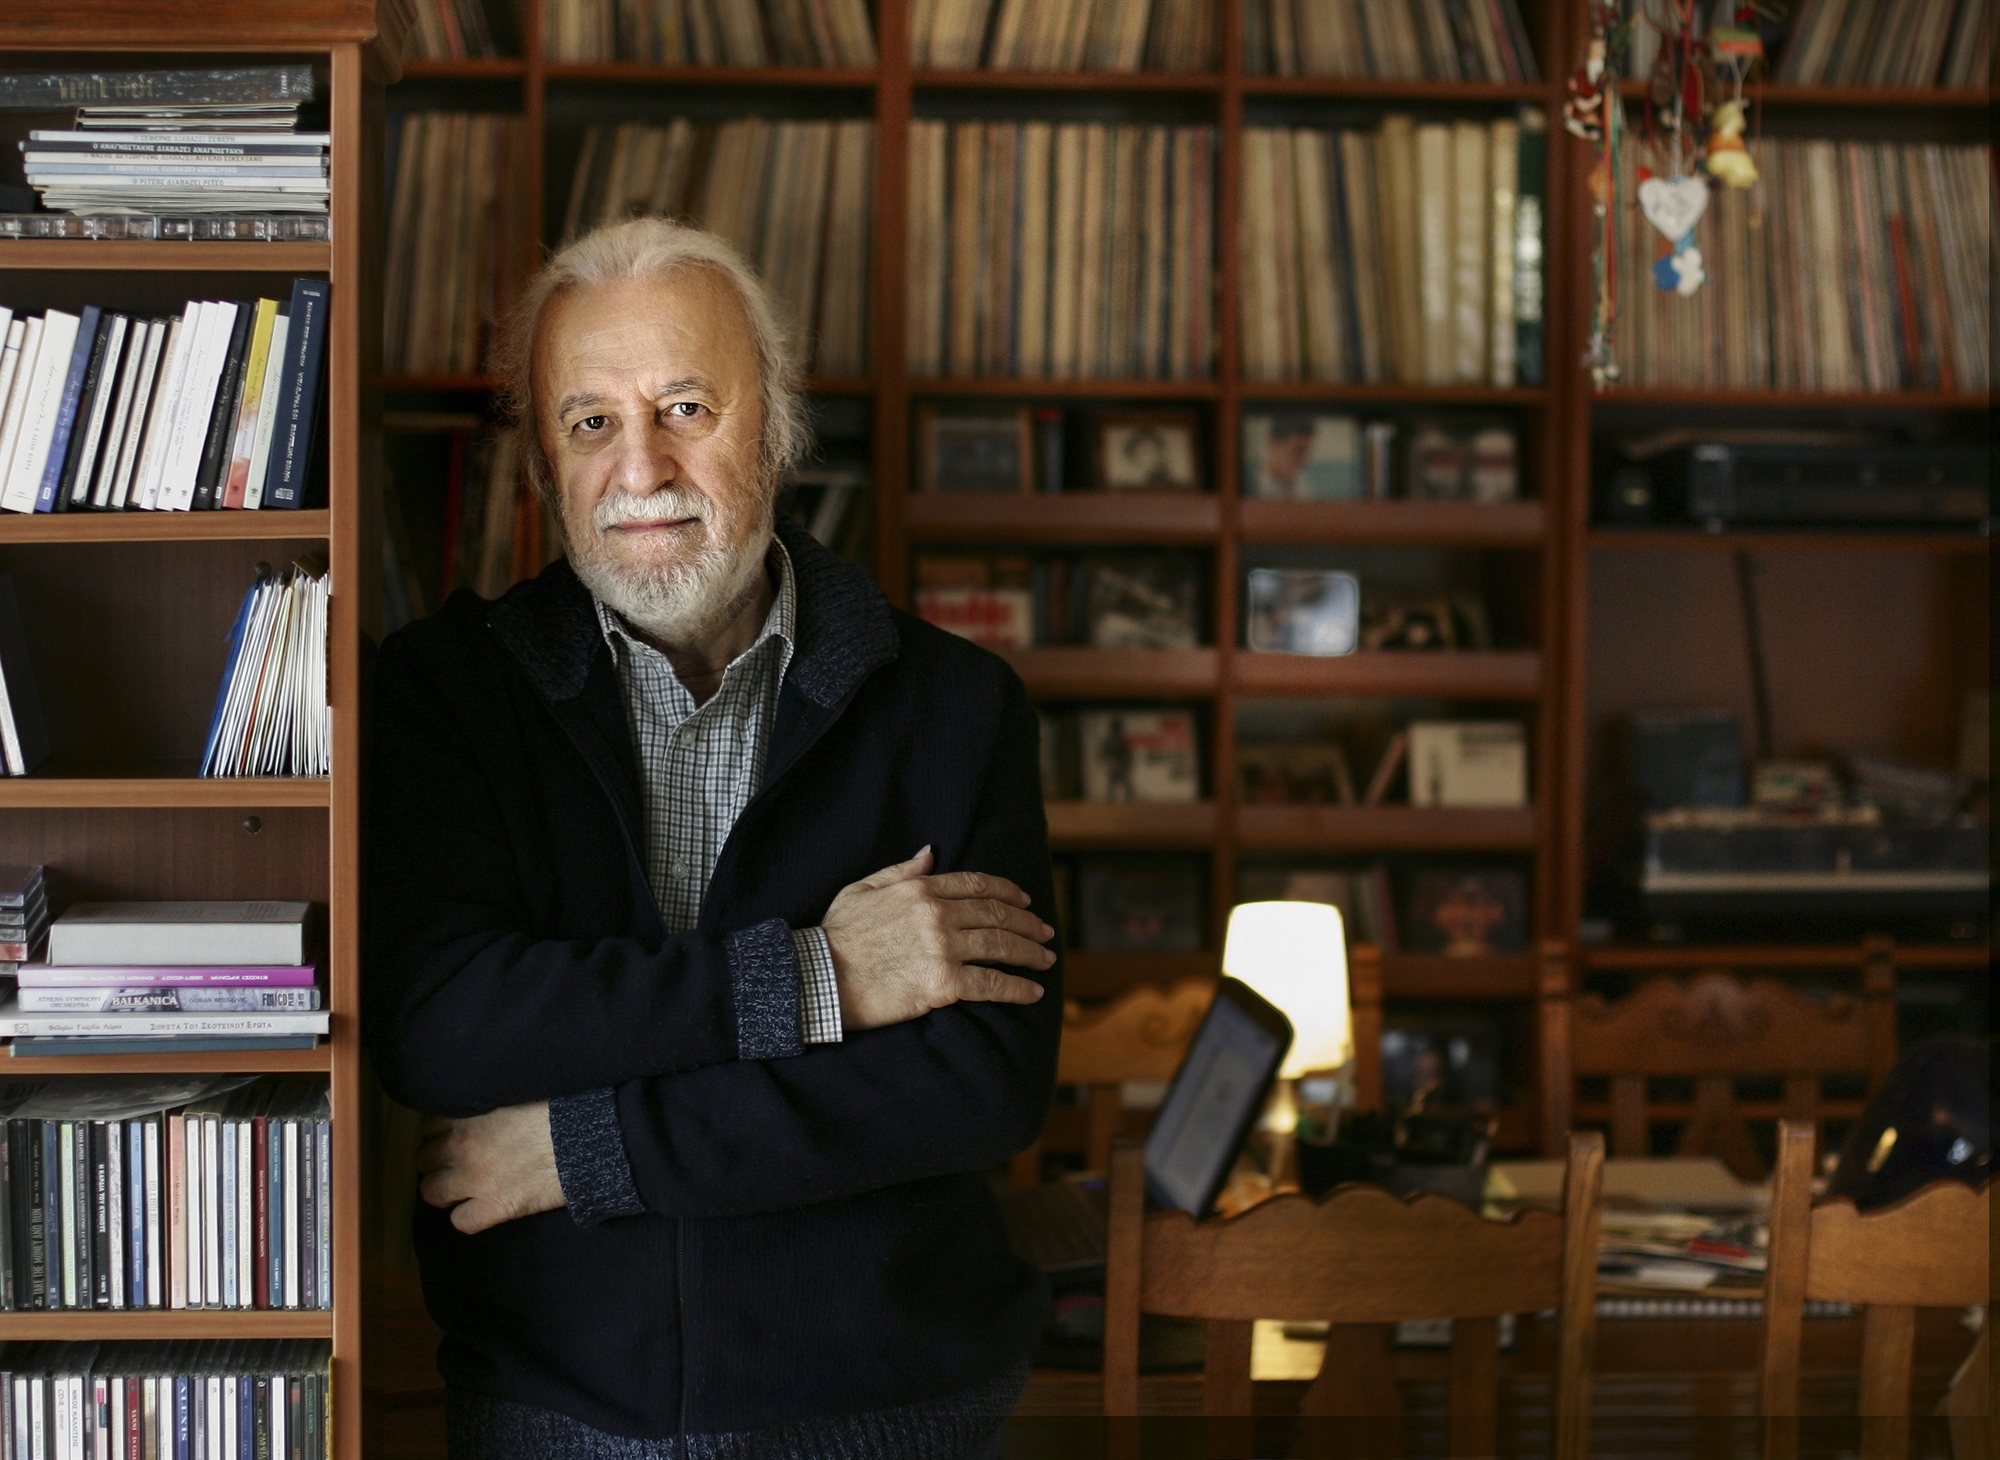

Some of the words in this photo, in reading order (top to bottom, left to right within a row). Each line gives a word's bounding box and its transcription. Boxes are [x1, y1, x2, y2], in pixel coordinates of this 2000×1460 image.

[157, 145, 190, 153] ΔΙΑΒΑΖΕΙ
[112, 996, 178, 1007] BALKANICA
[31, 1208, 43, 1223] RUN
[31, 1224, 43, 1239] AND
[32, 1240, 43, 1264] MONEY
[32, 1265, 43, 1278] THE
[33, 1279, 44, 1295] TAKE
